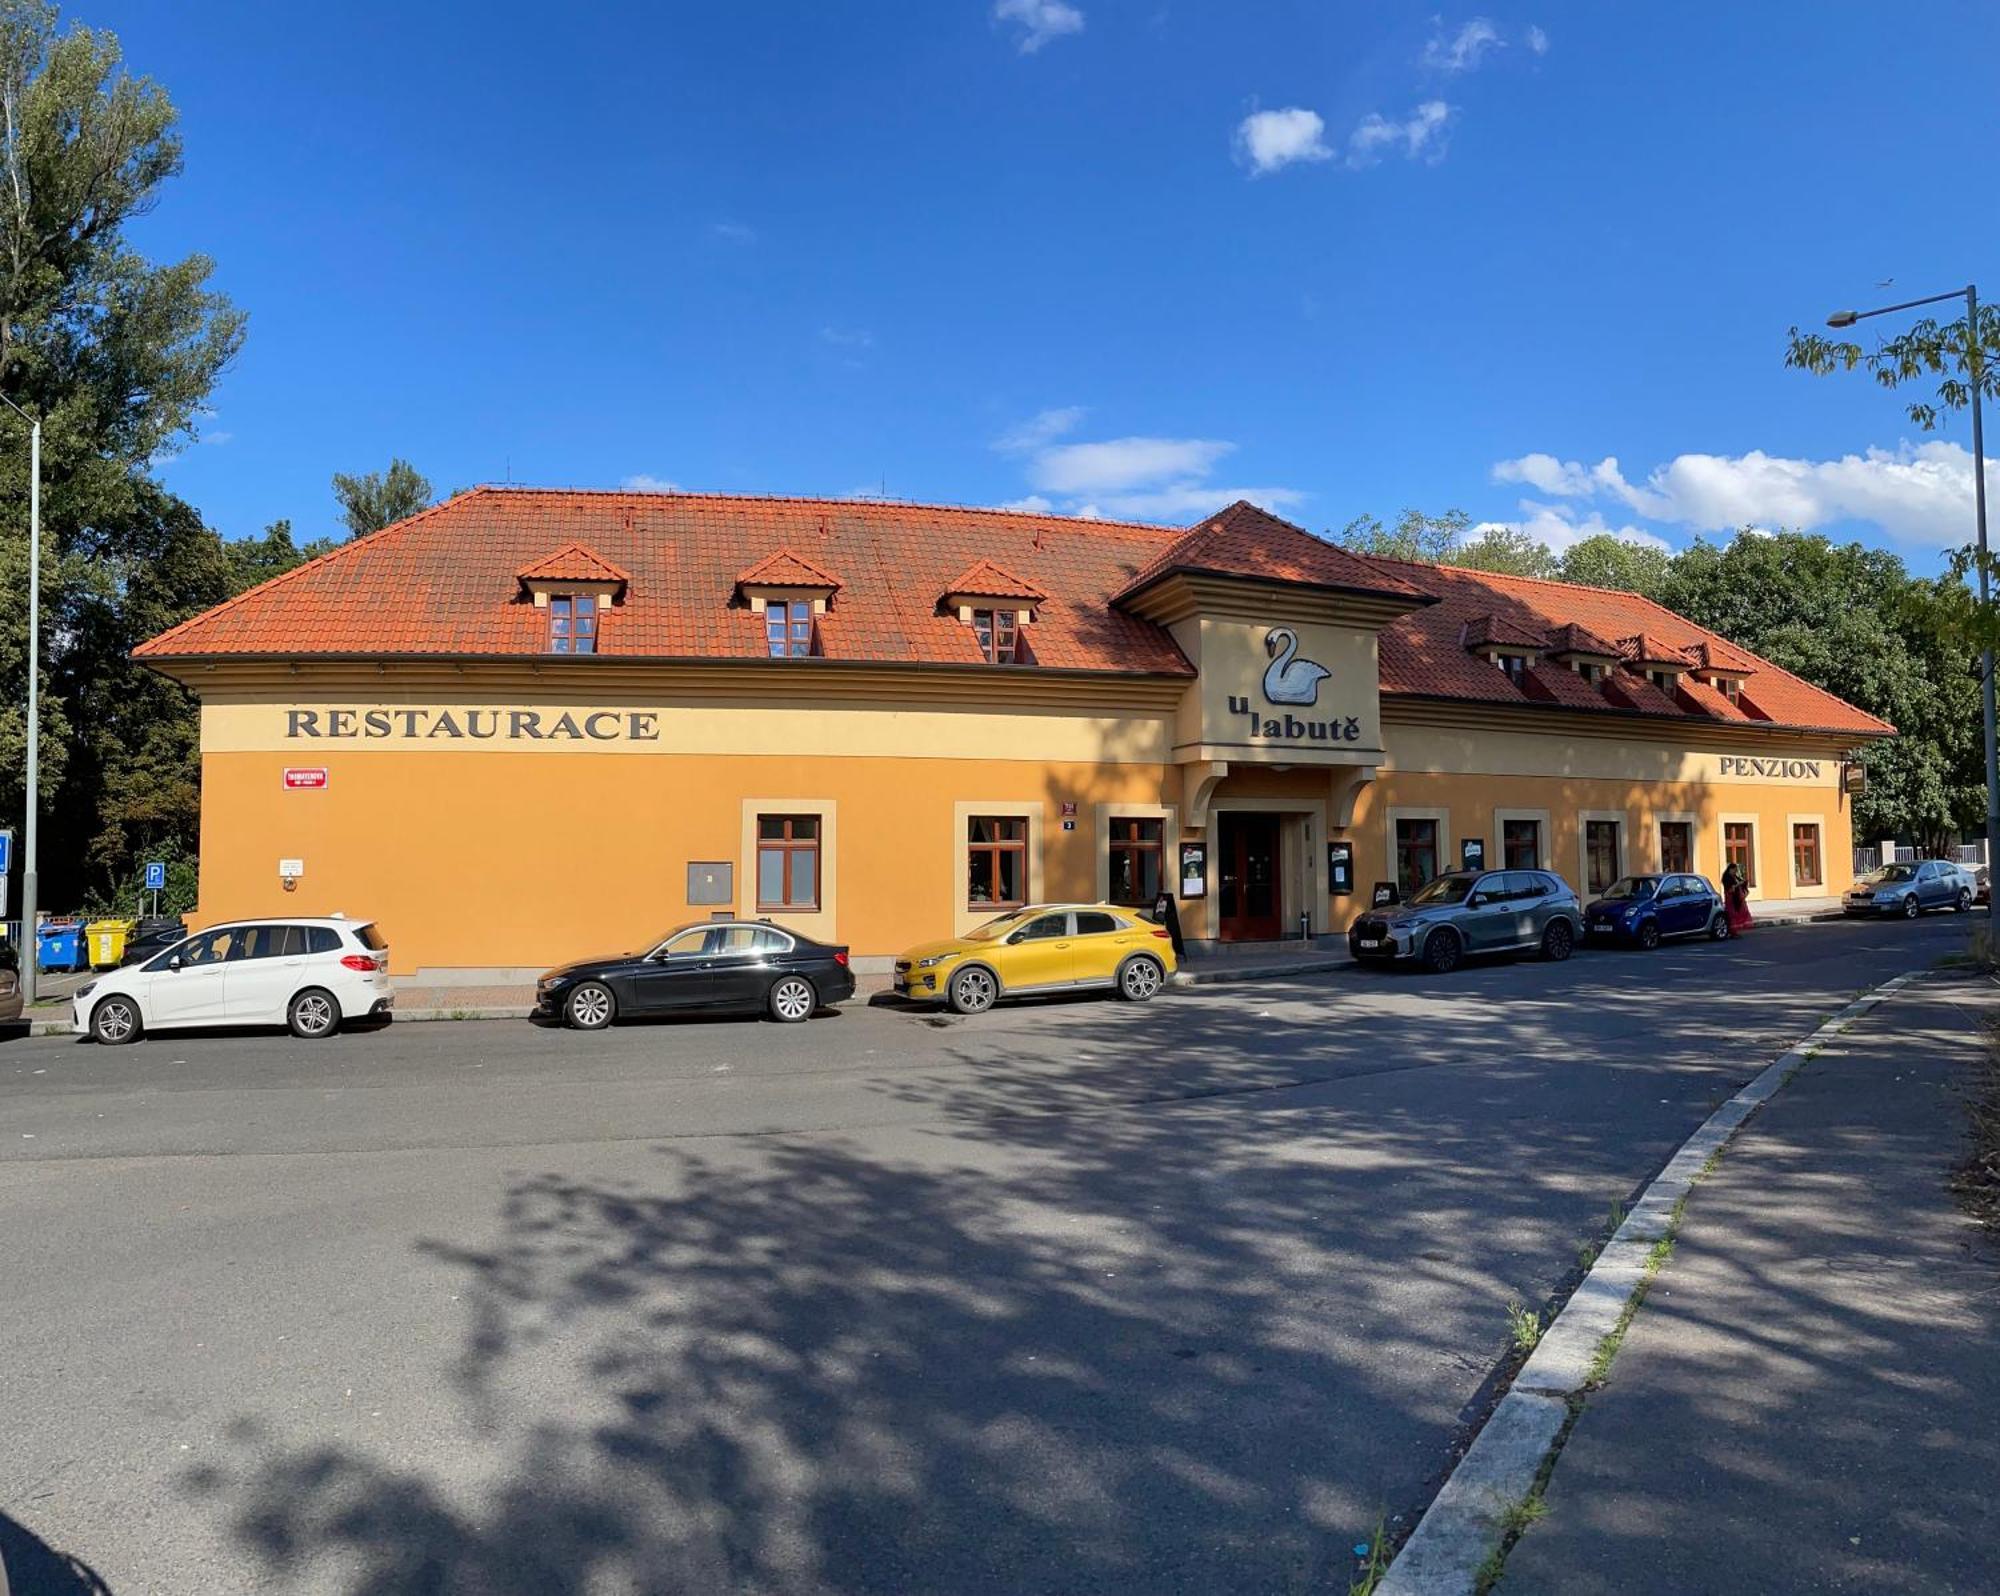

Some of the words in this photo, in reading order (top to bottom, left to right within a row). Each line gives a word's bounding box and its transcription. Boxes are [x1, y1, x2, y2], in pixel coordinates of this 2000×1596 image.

[284, 709, 660, 740] RESTAURACE
[1228, 695, 1249, 715] u
[1250, 711, 1361, 741] labutě
[1719, 757, 1820, 779] PENZION
